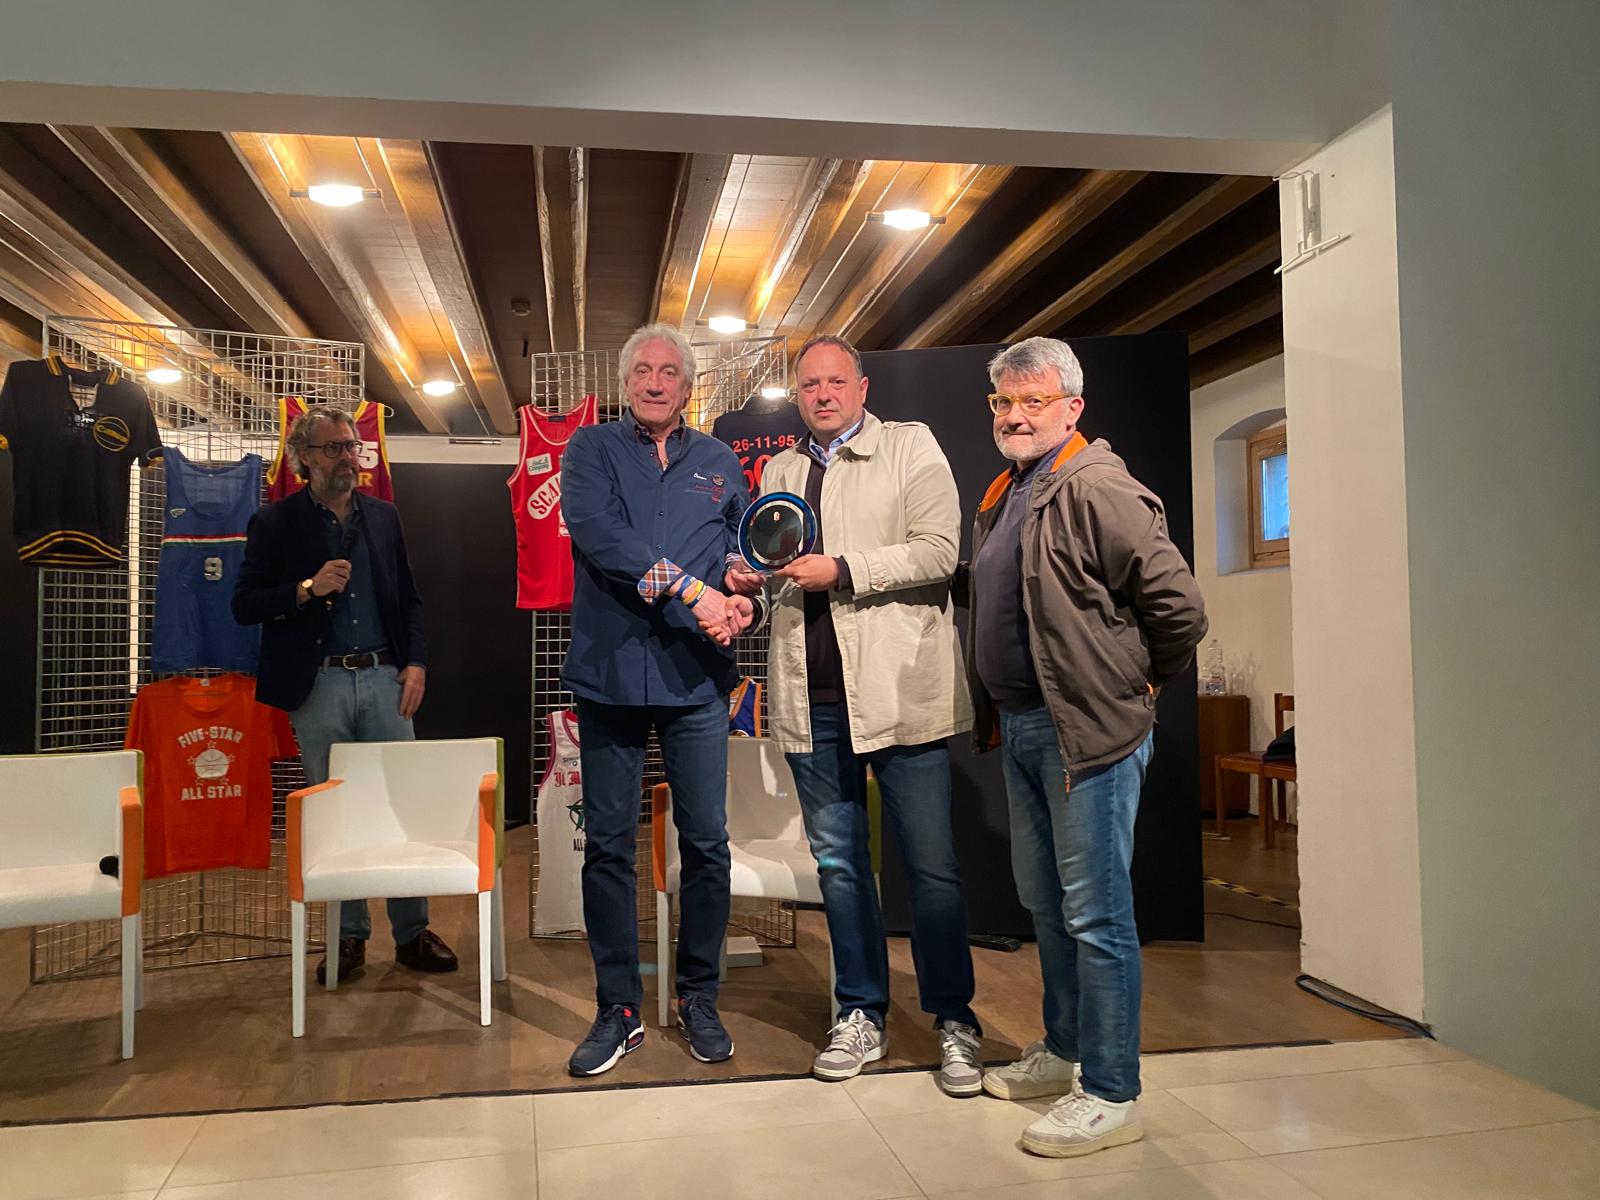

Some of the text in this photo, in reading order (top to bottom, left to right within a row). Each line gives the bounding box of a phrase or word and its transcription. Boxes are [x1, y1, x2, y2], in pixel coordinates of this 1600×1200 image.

[732, 434, 796, 453] 26-11-95
[530, 477, 561, 515] SCA
[204, 556, 223, 581] 9
[178, 726, 243, 748] FIVE-STAR
[182, 784, 242, 800] ALL STAR
